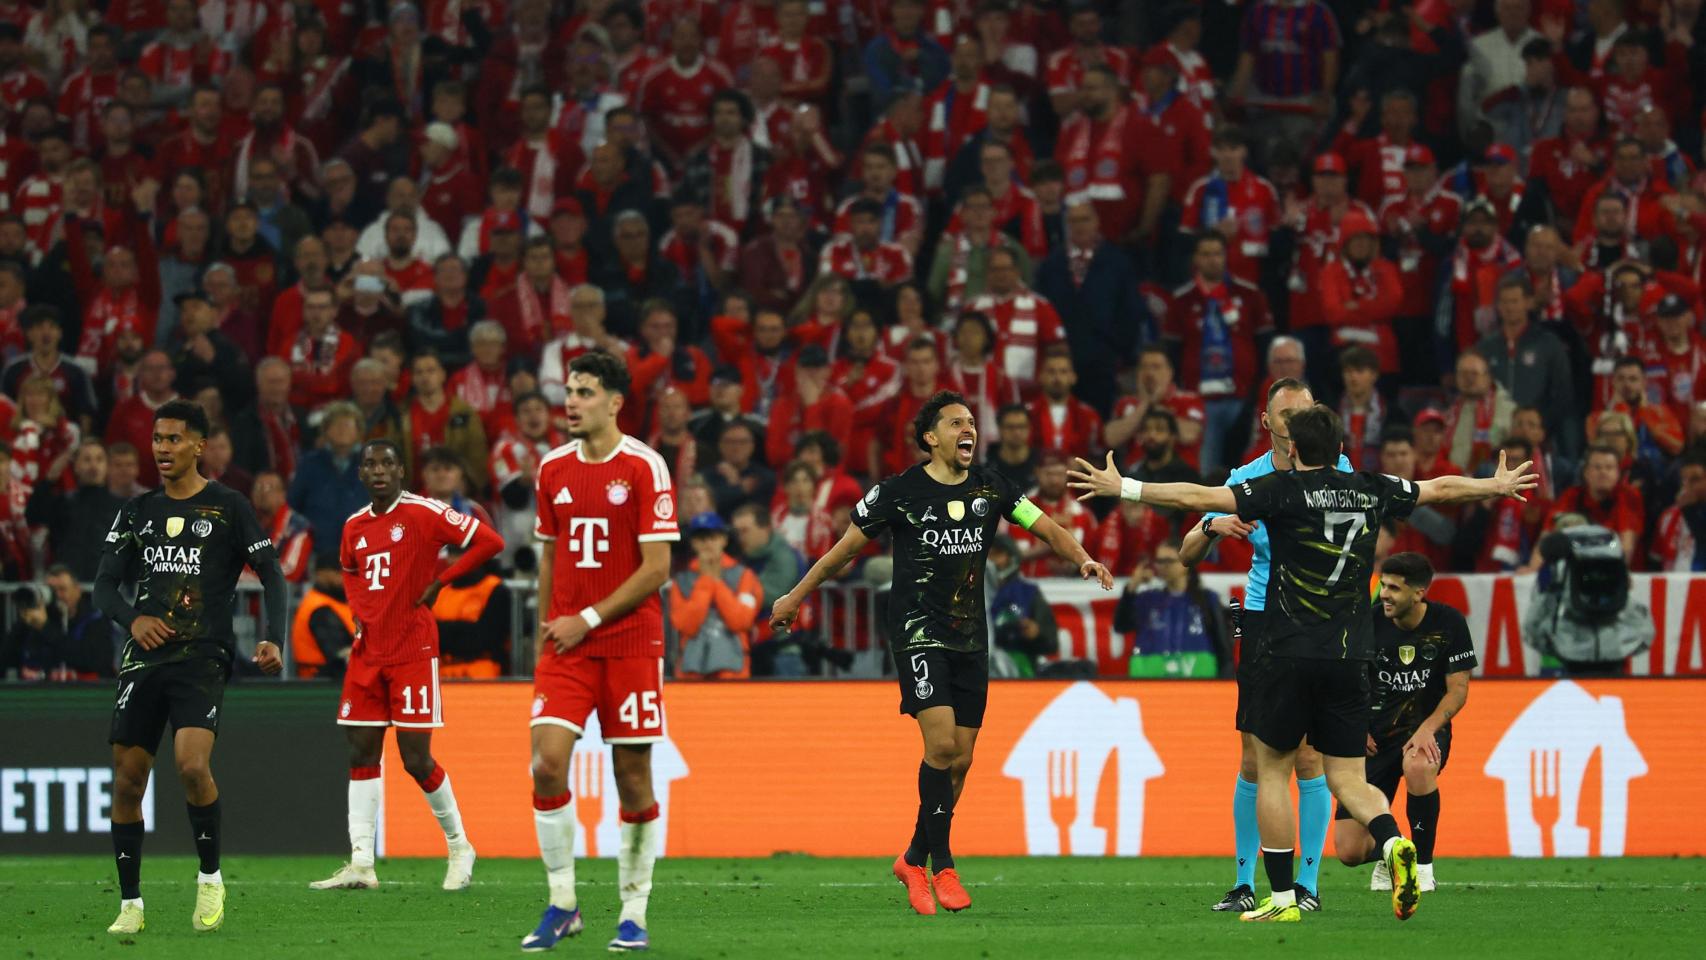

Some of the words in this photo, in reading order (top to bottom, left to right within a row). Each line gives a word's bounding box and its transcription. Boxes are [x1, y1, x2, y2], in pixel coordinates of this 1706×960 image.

[569, 517, 610, 568] T
[922, 527, 984, 546] QATAR
[939, 541, 983, 556] AIRWAYS
[1324, 512, 1367, 587] 7
[143, 545, 202, 565] QATAR
[152, 561, 202, 576] AIRWAYS
[365, 551, 391, 591] T
[911, 652, 929, 682] 5
[1378, 668, 1432, 685] QATAR
[401, 685, 431, 715] 11
[619, 690, 662, 731] 45
